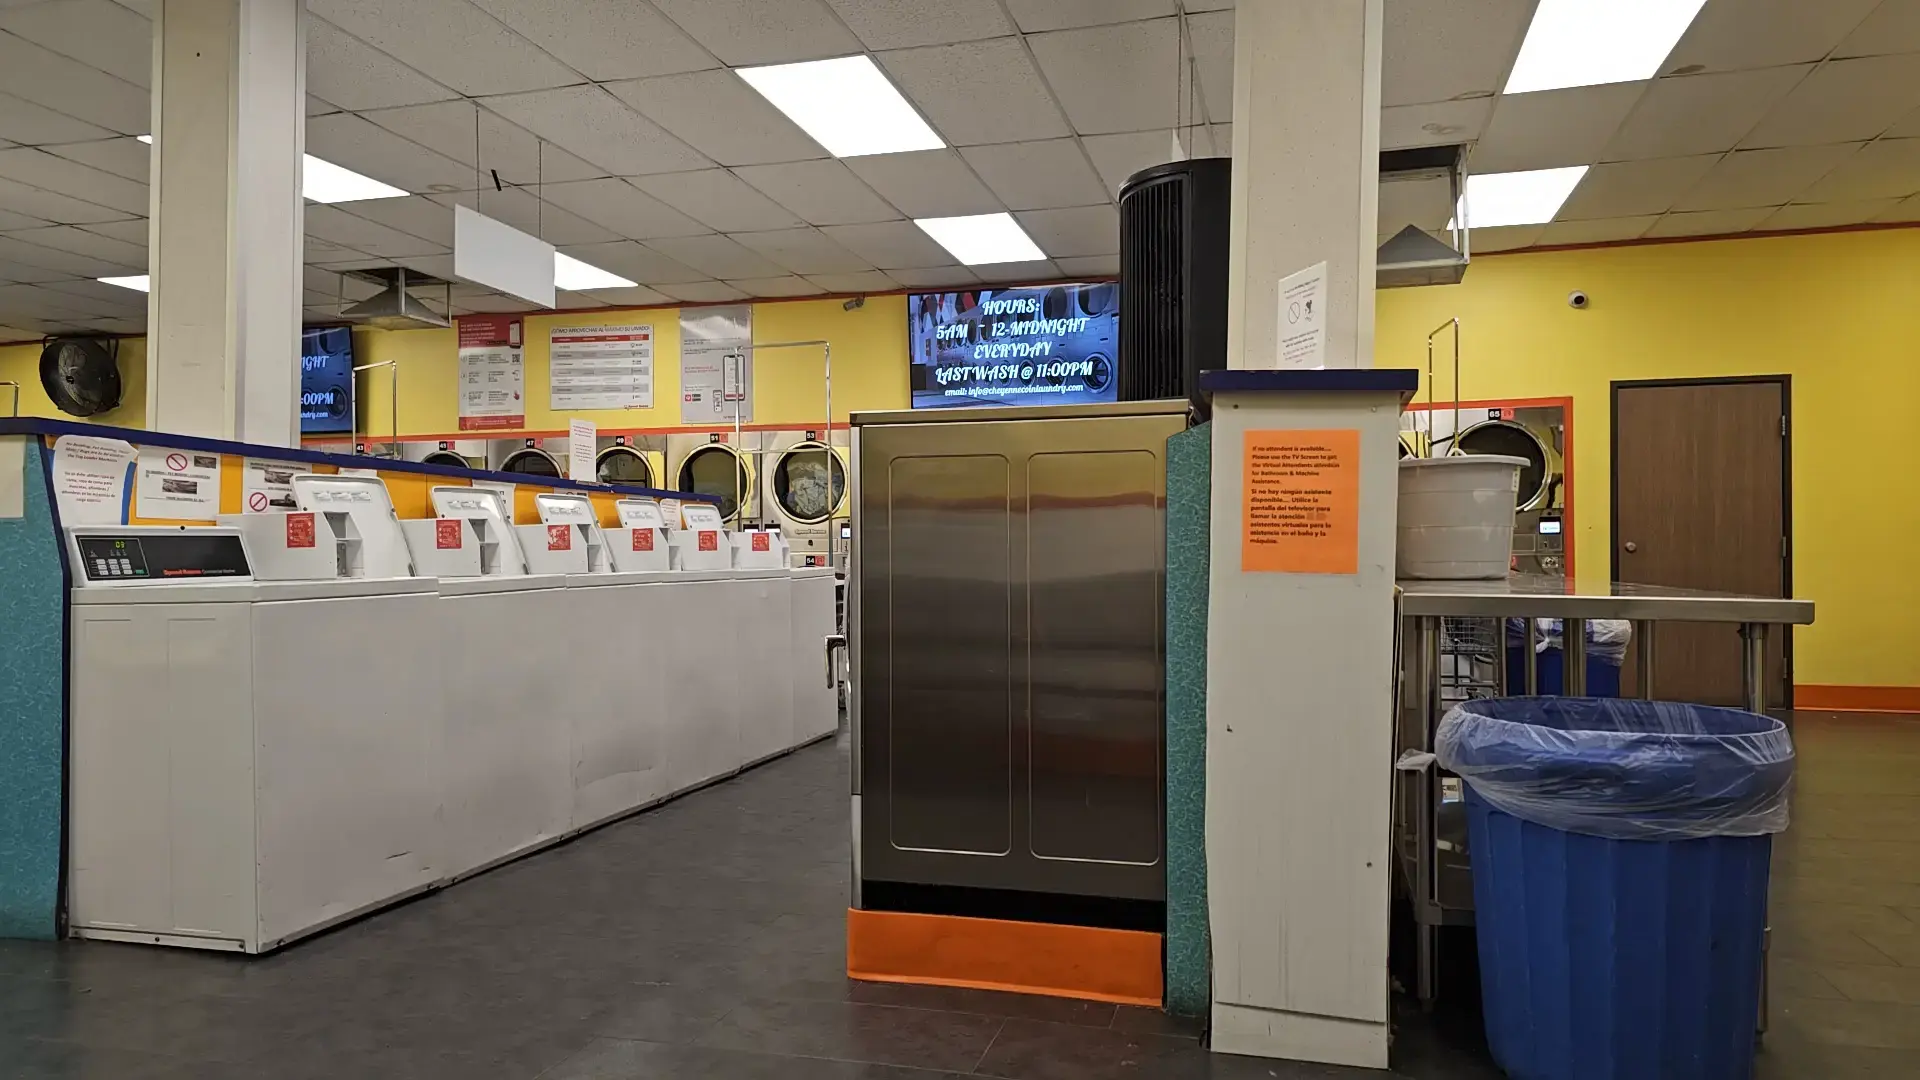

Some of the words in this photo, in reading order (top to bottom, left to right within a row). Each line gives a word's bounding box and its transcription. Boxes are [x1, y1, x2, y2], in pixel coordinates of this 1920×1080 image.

[982, 298, 1040, 315] HOURS:
[936, 323, 969, 340] 5AM
[992, 318, 1090, 336] 12-MIDNIGHT
[974, 341, 1053, 359] EVERYDAY
[935, 366, 973, 385] LAST
[971, 364, 1019, 381] WASH
[1021, 366, 1034, 380] @
[1036, 361, 1093, 378] 11:00PM
[945, 387, 967, 396] email:
